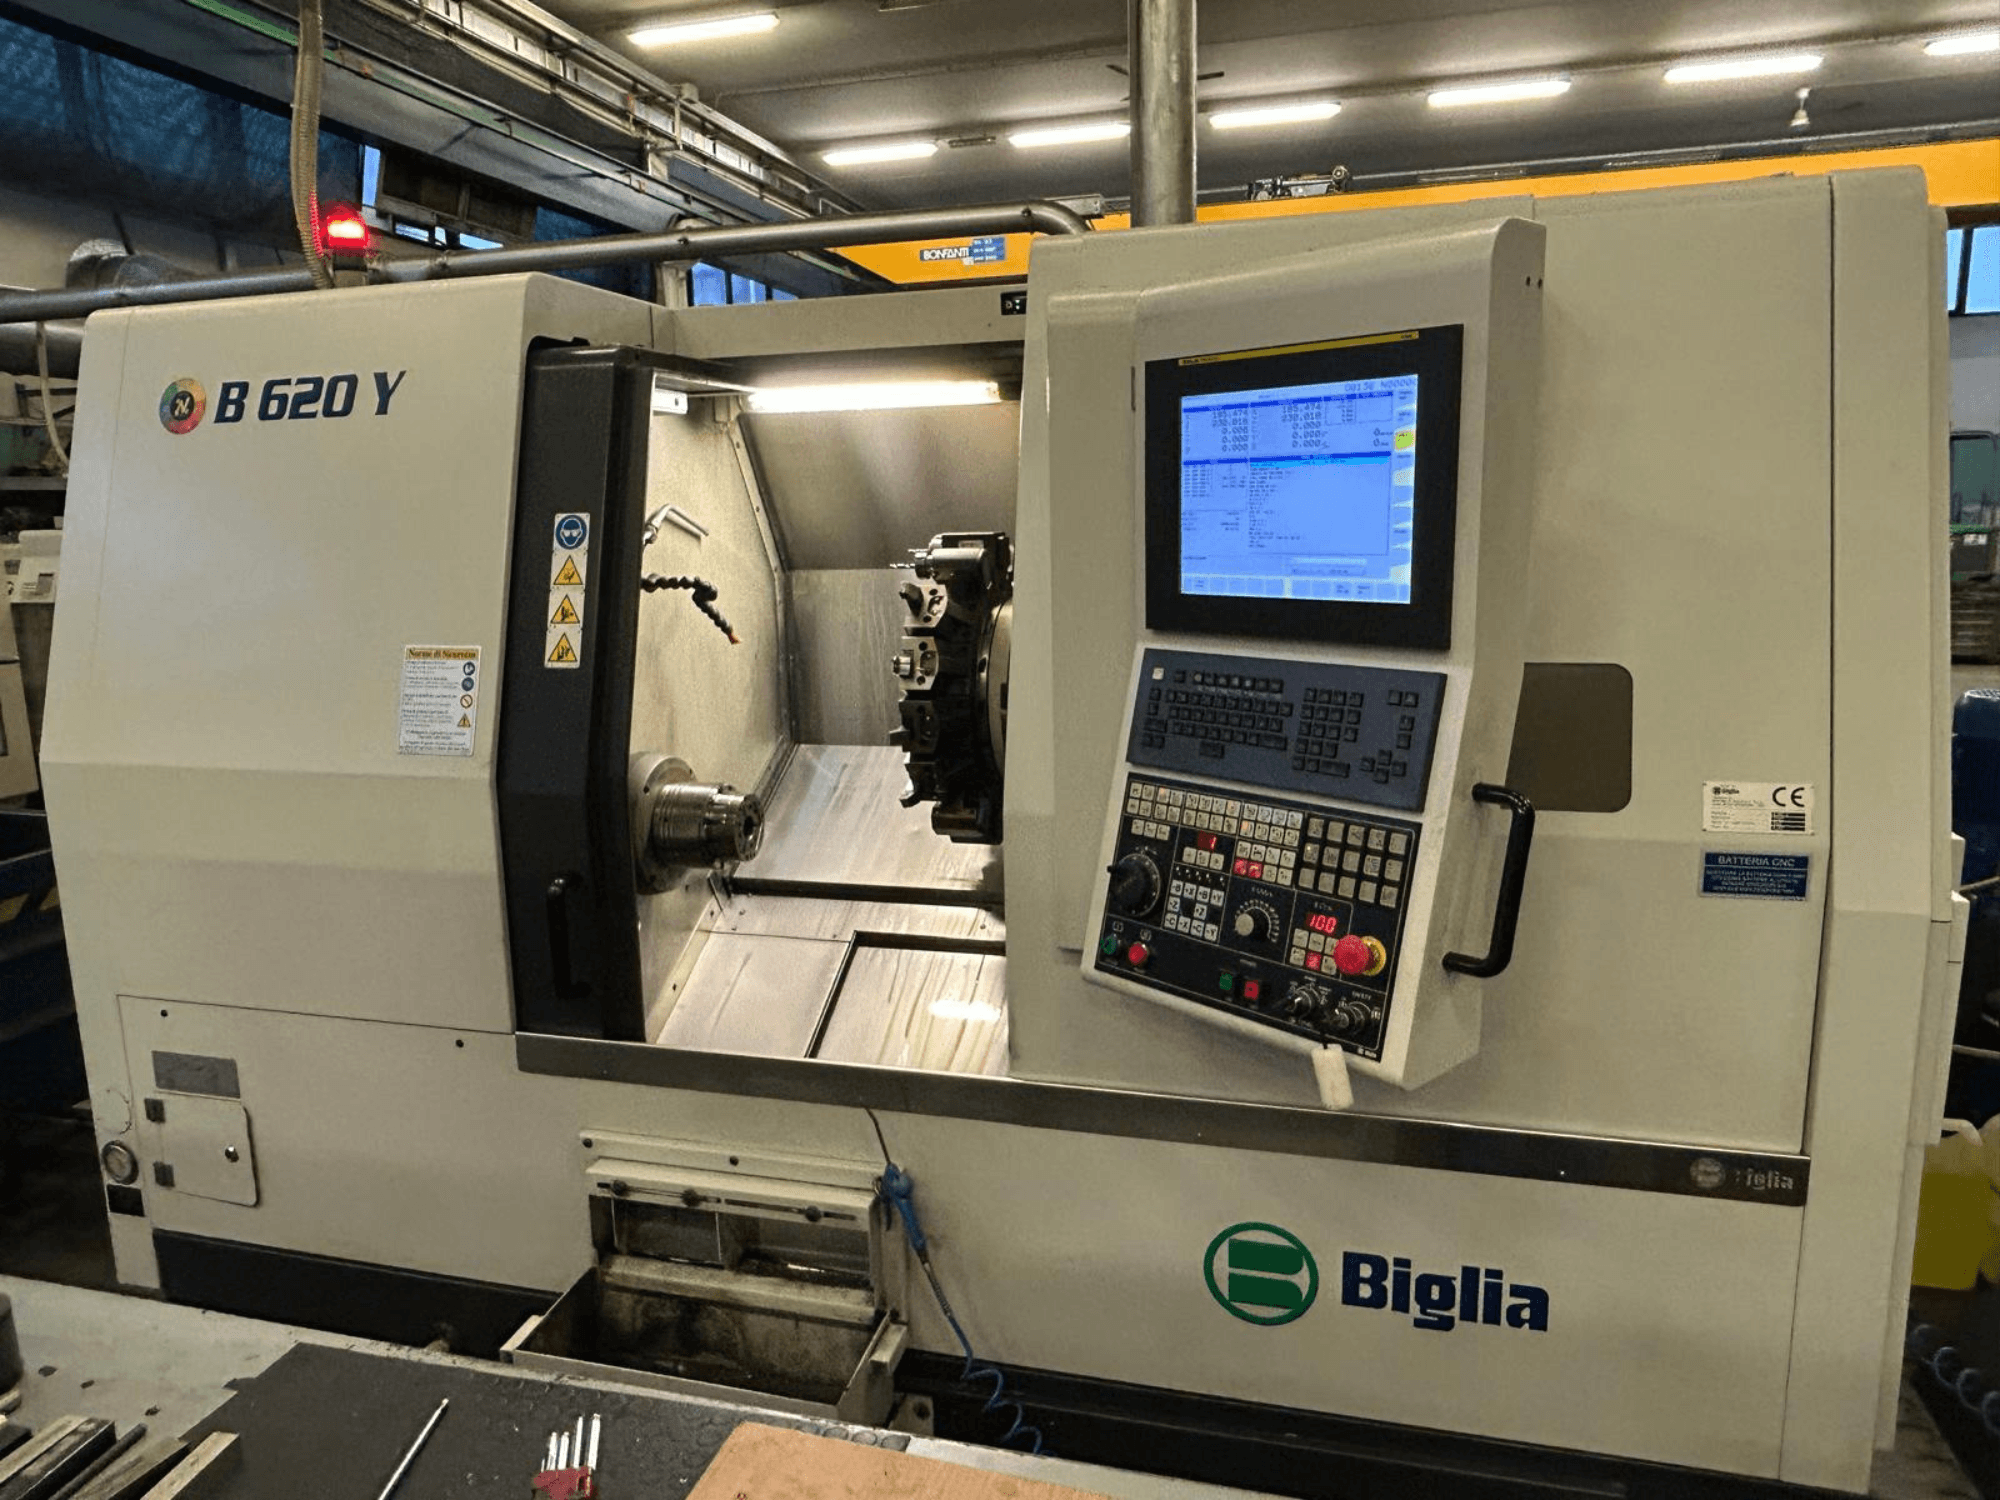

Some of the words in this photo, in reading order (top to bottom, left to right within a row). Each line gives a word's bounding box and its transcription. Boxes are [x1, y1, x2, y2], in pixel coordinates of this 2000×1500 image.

[214, 381, 249, 424] B
[258, 373, 358, 421] 620
[374, 370, 407, 415] Y
[1772, 786, 1805, 808] CE
[1718, 855, 1769, 866] BATTERIA
[1771, 858, 1796, 868] CNC
[1309, 914, 1337, 934] 100
[1735, 1168, 1794, 1190] iglia
[1341, 1250, 1550, 1331] Biglia
